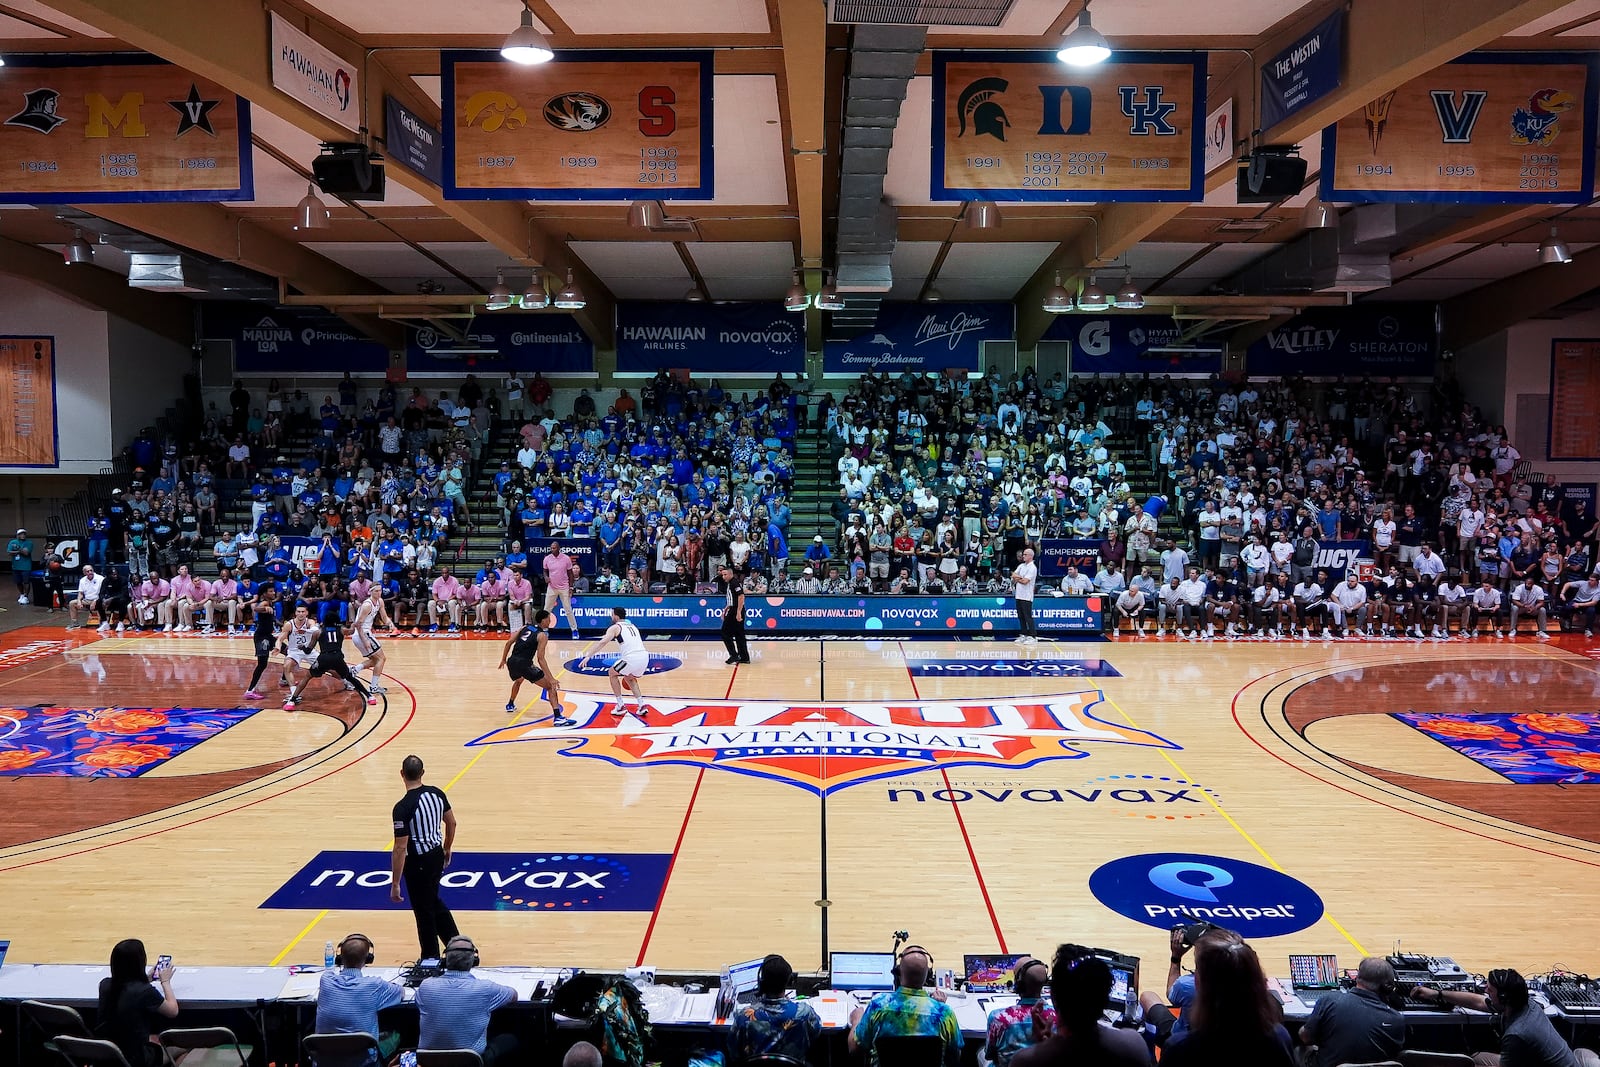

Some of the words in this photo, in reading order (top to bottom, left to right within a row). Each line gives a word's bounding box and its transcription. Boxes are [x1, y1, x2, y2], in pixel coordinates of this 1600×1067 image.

[1274, 57, 1291, 79] THE
[1290, 35, 1320, 69] WESTIN
[281, 45, 333, 92] HAWAIIAN
[400, 110, 411, 132] THE
[410, 118, 433, 146] WESTIN
[1526, 119, 1544, 131] KU
[640, 148, 677, 158] 1990
[1024, 152, 1062, 163] 1992
[1068, 152, 1107, 163] 2007
[100, 154, 137, 164] 1985
[179, 159, 216, 170] 1986
[478, 157, 516, 168] 1987
[560, 157, 597, 168] 1989
[967, 157, 1000, 168] 1991
[1131, 158, 1169, 169] 1993
[19, 161, 57, 172] 1984
[640, 160, 677, 170] 1998
[1024, 164, 1062, 175] 1997
[1067, 164, 1105, 175] 2011
[1356, 165, 1393, 176] 1994
[100, 167, 138, 177] 1988
[1437, 166, 1475, 176] 1995
[1520, 166, 1558, 177] 2015
[638, 172, 677, 183] 2013
[1023, 176, 1059, 187] 2001
[1520, 178, 1558, 189] 2019
[243, 330, 293, 341] MAUNA
[623, 327, 706, 340] HAWAIIAN
[915, 315, 948, 338] Maui
[948, 312, 989, 350] Jim
[511, 332, 572, 345] Continental
[719, 332, 792, 343] novavax
[1079, 321, 1110, 356] G
[1267, 329, 1340, 353] VALLEY
[258, 342, 278, 352] LOA
[644, 342, 686, 350] AIRLINES
[1350, 342, 1428, 353] SHERATON
[842, 353, 881, 367] Tommy
[881, 353, 924, 363] Bahama
[1057, 557, 1094, 566] LIVE
[646, 609, 688, 617] DIFFERENT
[780, 609, 865, 617] CHOOSENOVAVAX.COM
[882, 609, 938, 618] novavax
[955, 609, 979, 618] COVID
[1043, 609, 1085, 618] DIFFERENT
[327, 632, 338, 643] 11
[520, 631, 532, 640] 2
[629, 627, 637, 637] 11
[296, 637, 307, 645] 20
[575, 703, 1077, 731] MAUI
[665, 730, 982, 749] INVITATIONAL
[724, 748, 922, 757] CHAMINADE
[888, 789, 1200, 803] novavax
[310, 869, 611, 889] noavax
[1144, 903, 1290, 920] Principal
